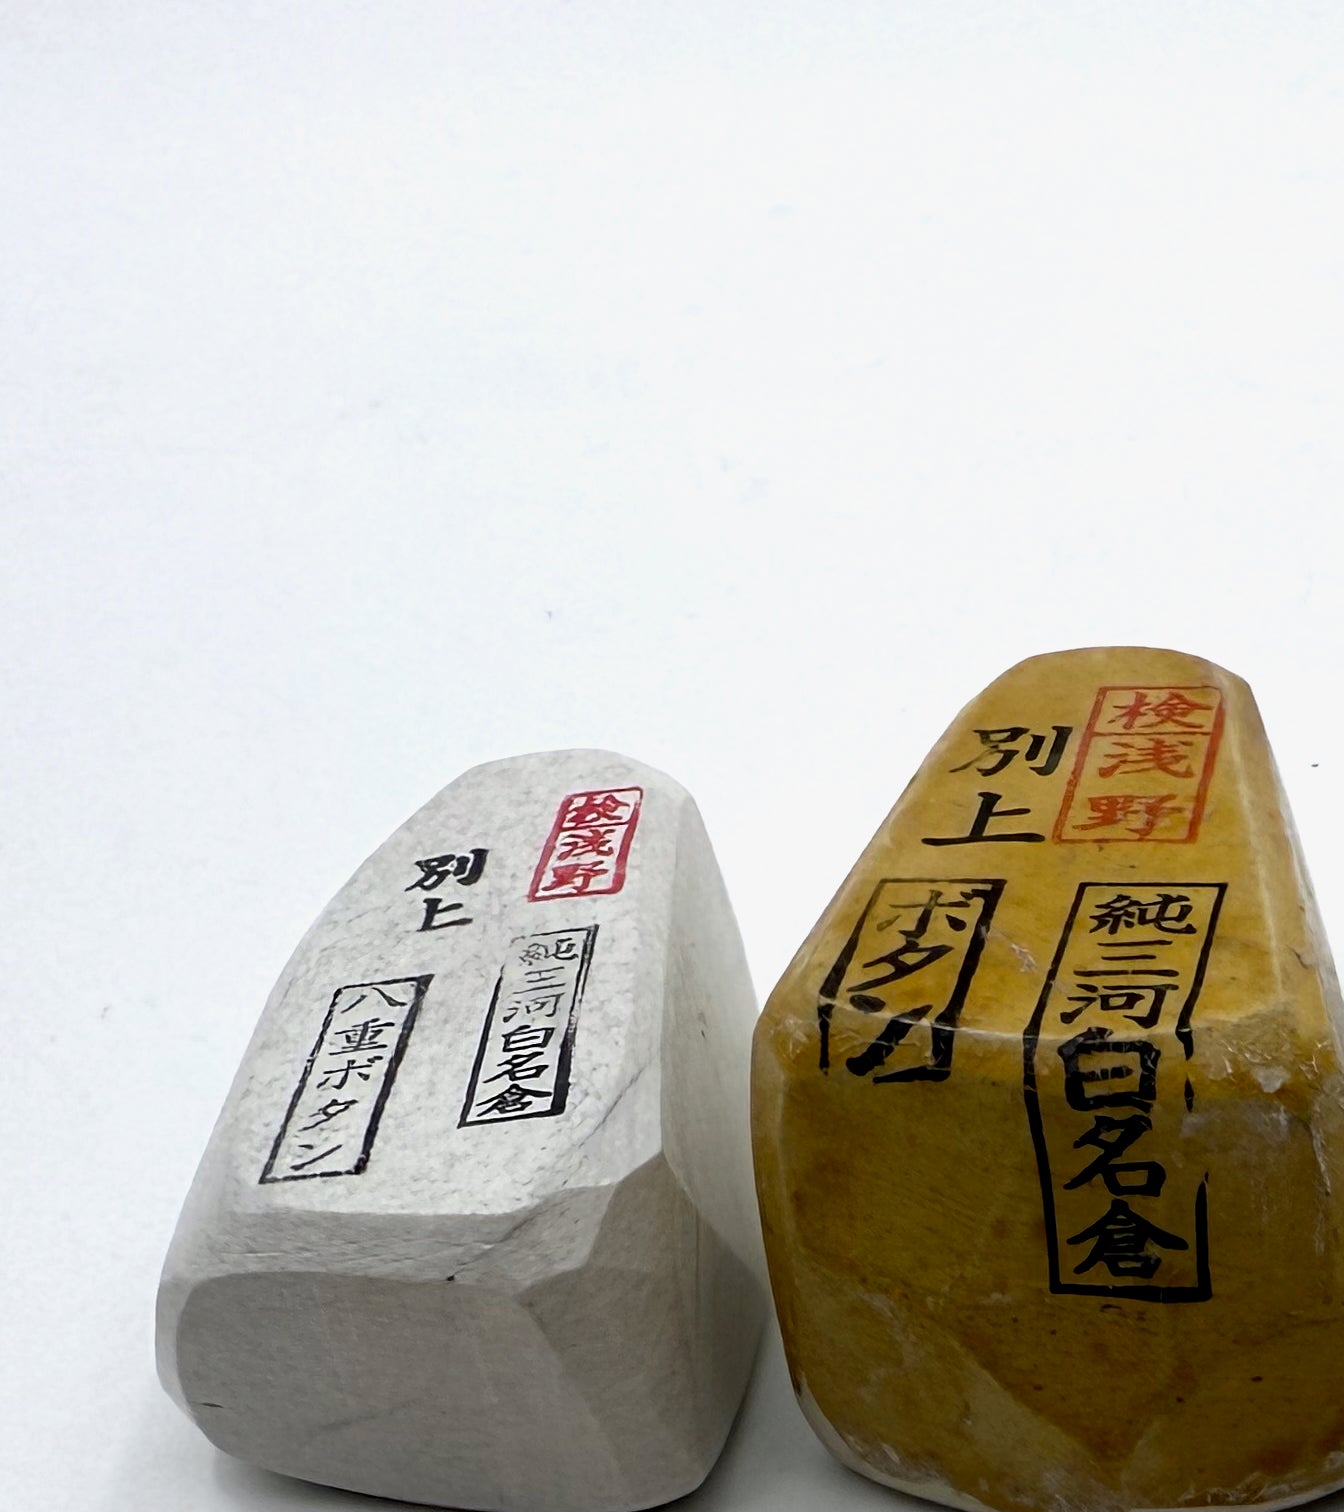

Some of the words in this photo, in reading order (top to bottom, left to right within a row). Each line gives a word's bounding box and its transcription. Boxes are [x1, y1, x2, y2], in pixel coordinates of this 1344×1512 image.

[921, 726, 1073, 845] 別上
[404, 848, 489, 932] 別上
[291, 986, 407, 1171] 八重ボタン
[1057, 893, 1198, 1279] 純三河白名倉
